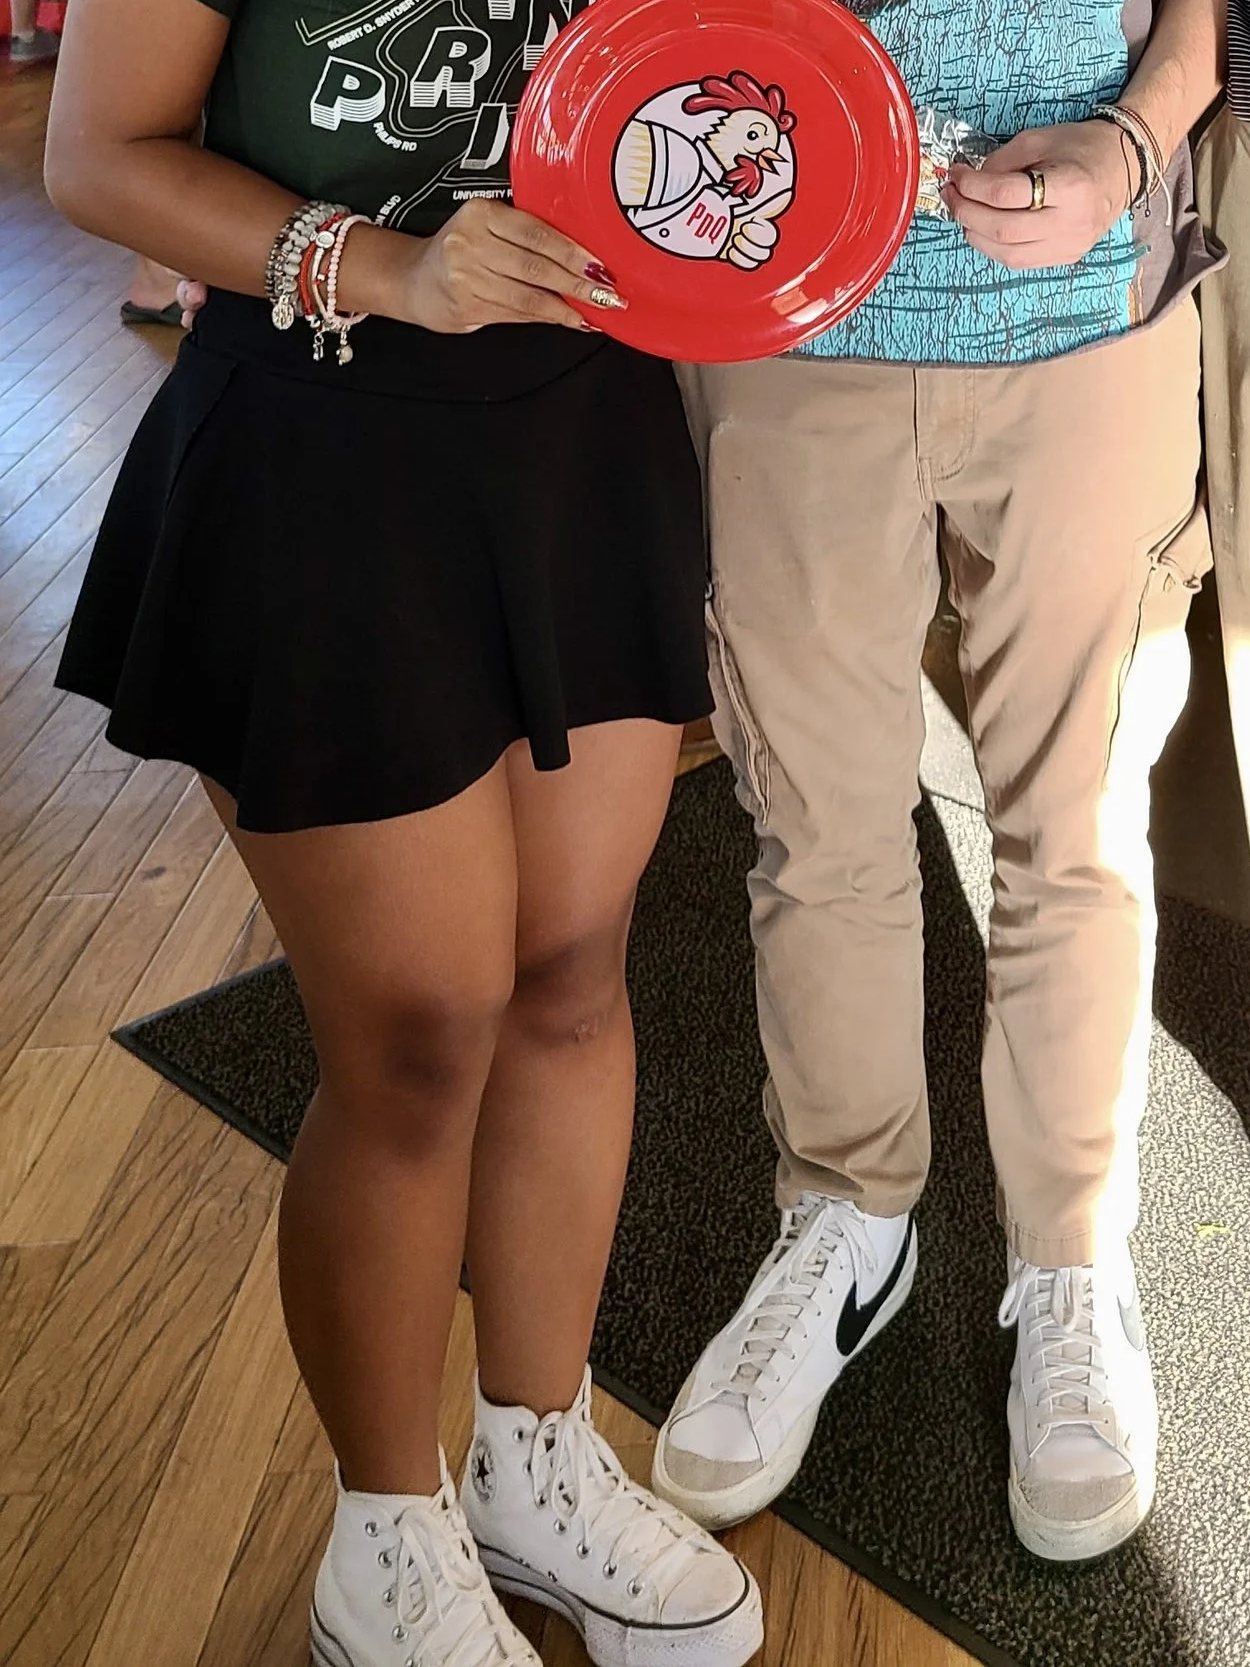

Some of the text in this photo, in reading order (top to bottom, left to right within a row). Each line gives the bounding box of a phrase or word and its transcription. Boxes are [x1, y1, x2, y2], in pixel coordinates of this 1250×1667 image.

[327, 27, 363, 51] ROBERT
[401, 141, 418, 152] RD
[380, 194, 402, 216] BLVD
[452, 189, 506, 200] UNIVERSITY
[686, 202, 728, 245] PDQ
